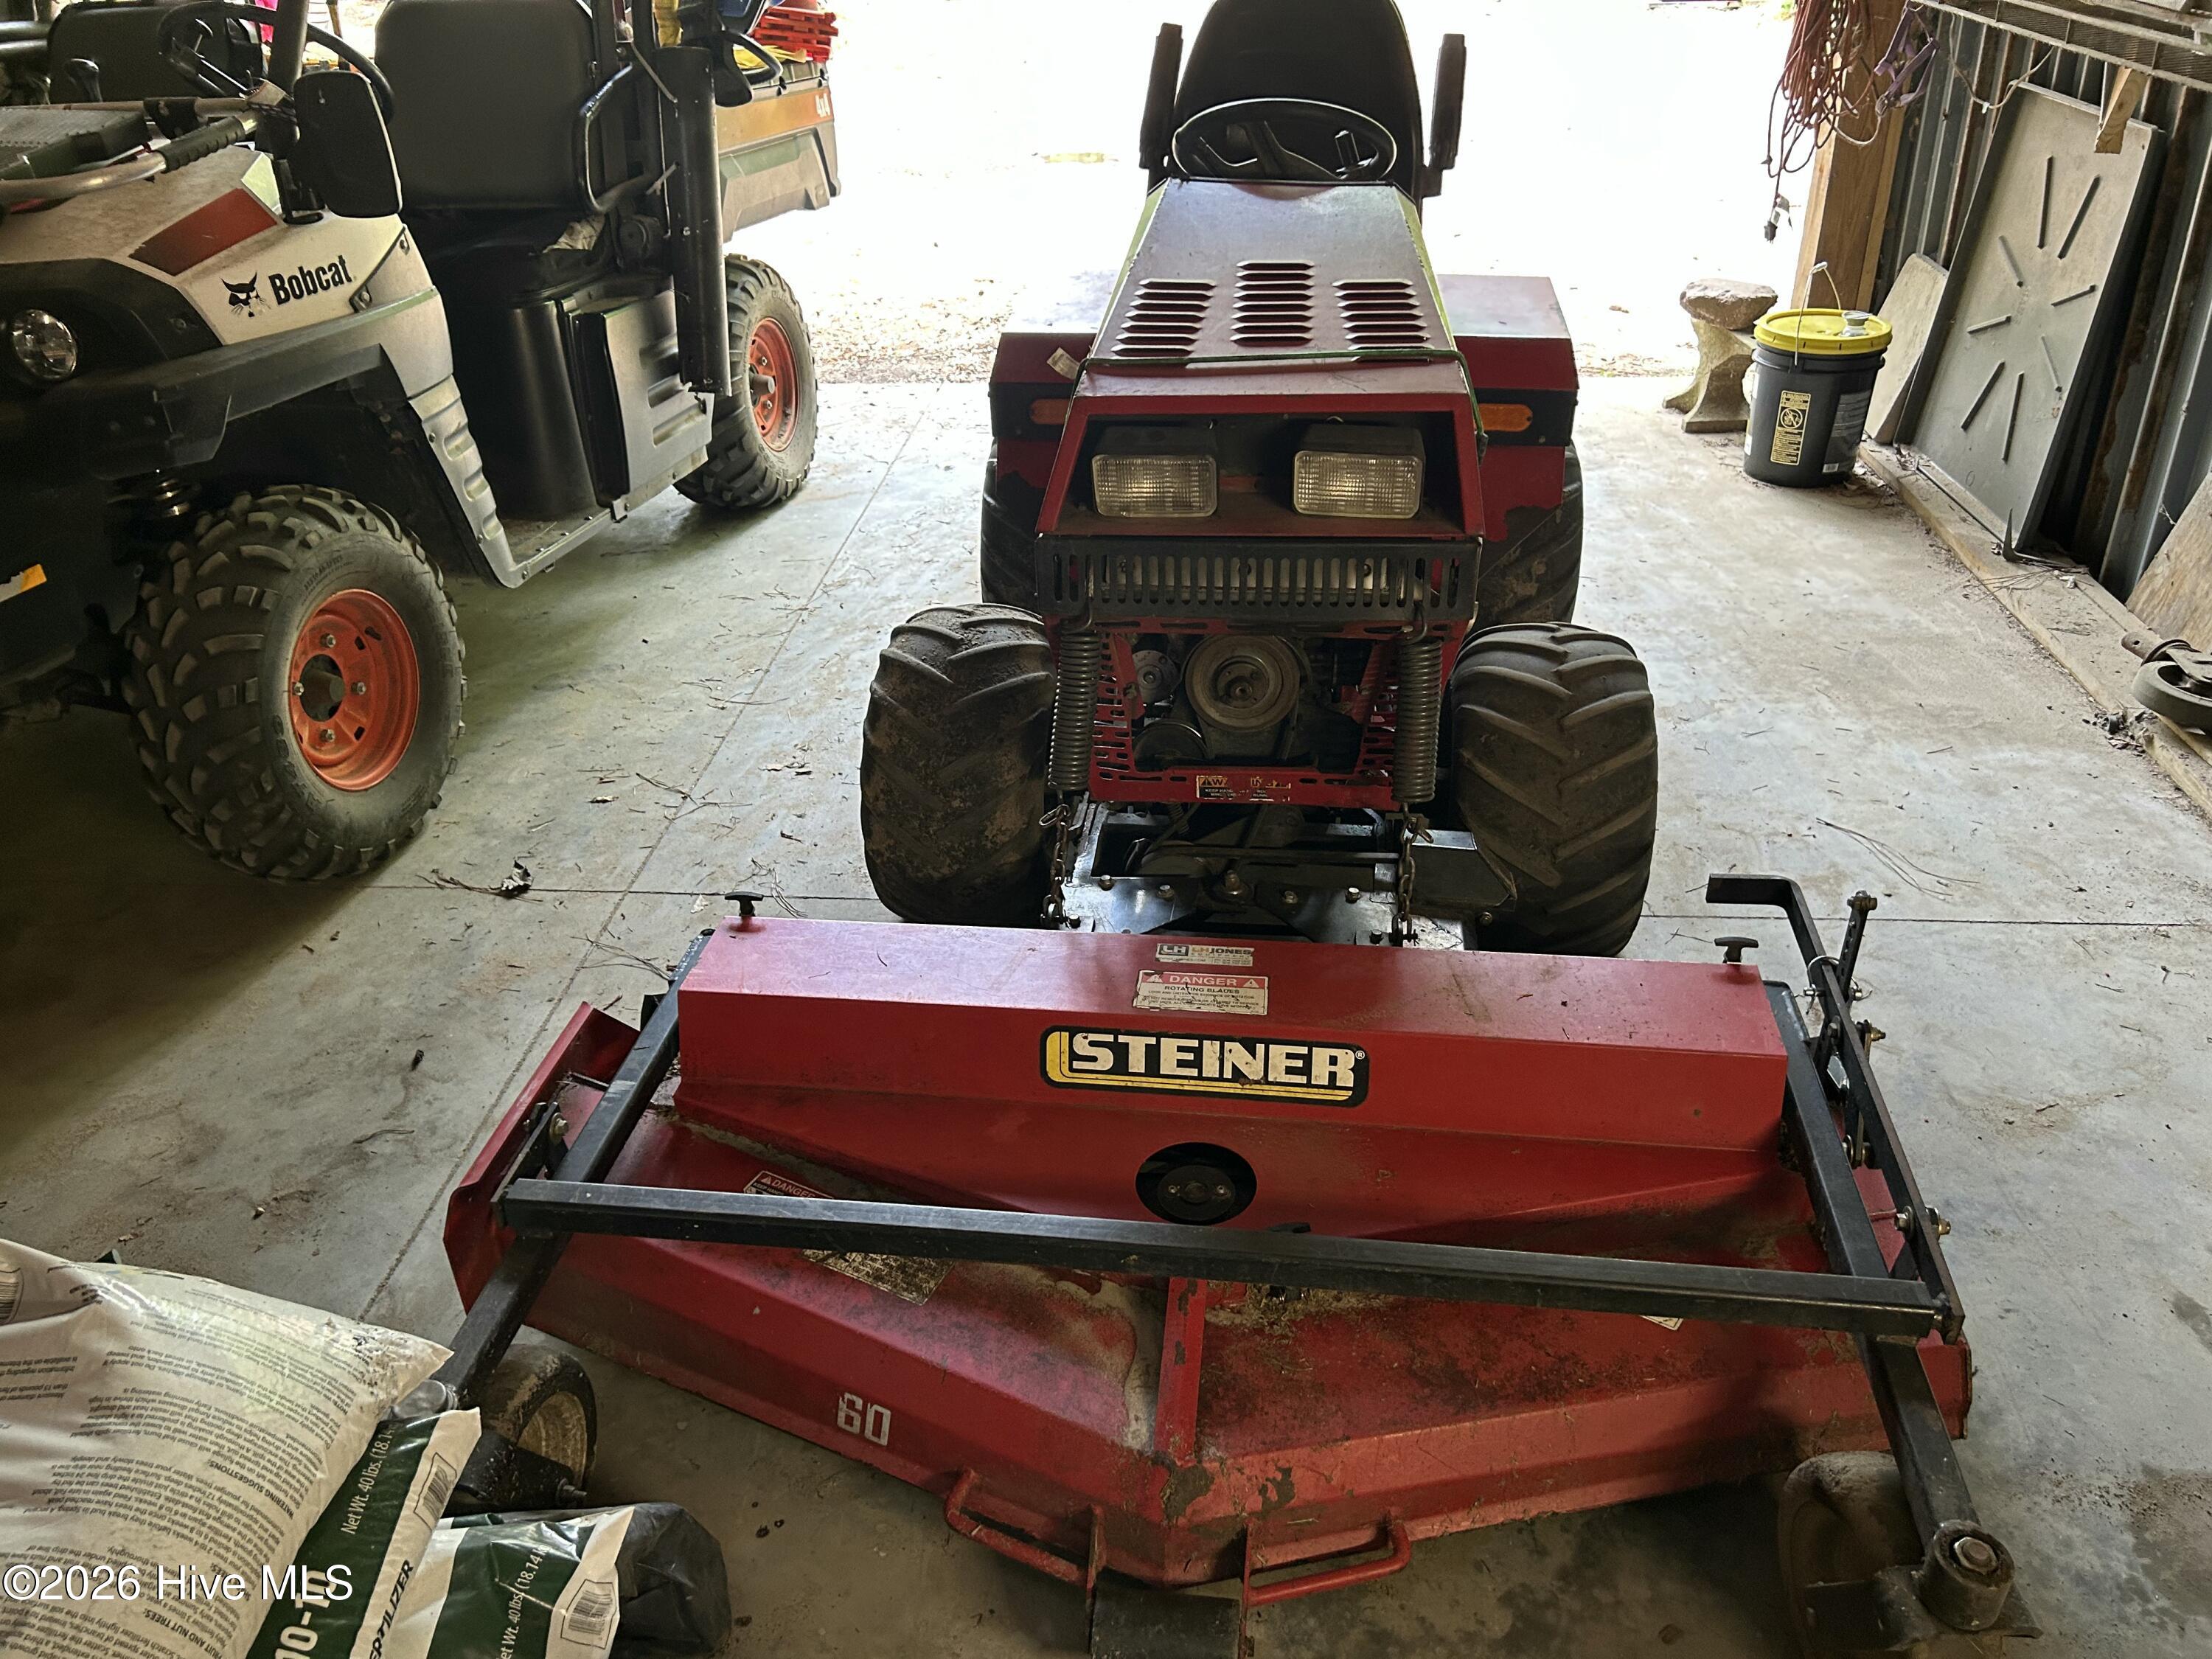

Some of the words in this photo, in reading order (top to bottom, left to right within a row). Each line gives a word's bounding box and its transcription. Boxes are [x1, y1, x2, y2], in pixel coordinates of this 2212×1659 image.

[815, 93, 830, 118] 4x4
[268, 254, 352, 305] Bobcat
[1169, 975, 1237, 986] DANGER
[1072, 1032, 1354, 1088] STEINER
[837, 1392, 891, 1446] 60
[206, 1458, 264, 1494] SUGGESTIONS:
[364, 1460, 383, 1477] lbs.
[358, 1477, 375, 1492] 40
[263, 1488, 295, 1520] WATERING
[349, 1494, 369, 1512] Wt.
[341, 1513, 361, 1534] Net
[516, 1554, 543, 1589] (18.14
[142, 1607, 172, 1629] TREES:
[369, 1559, 413, 1659] ERTILIZER
[508, 1606, 521, 1624] 40
[170, 1621, 189, 1639] NUT
[188, 1631, 206, 1650] AND
[502, 1626, 520, 1646] Wt.
